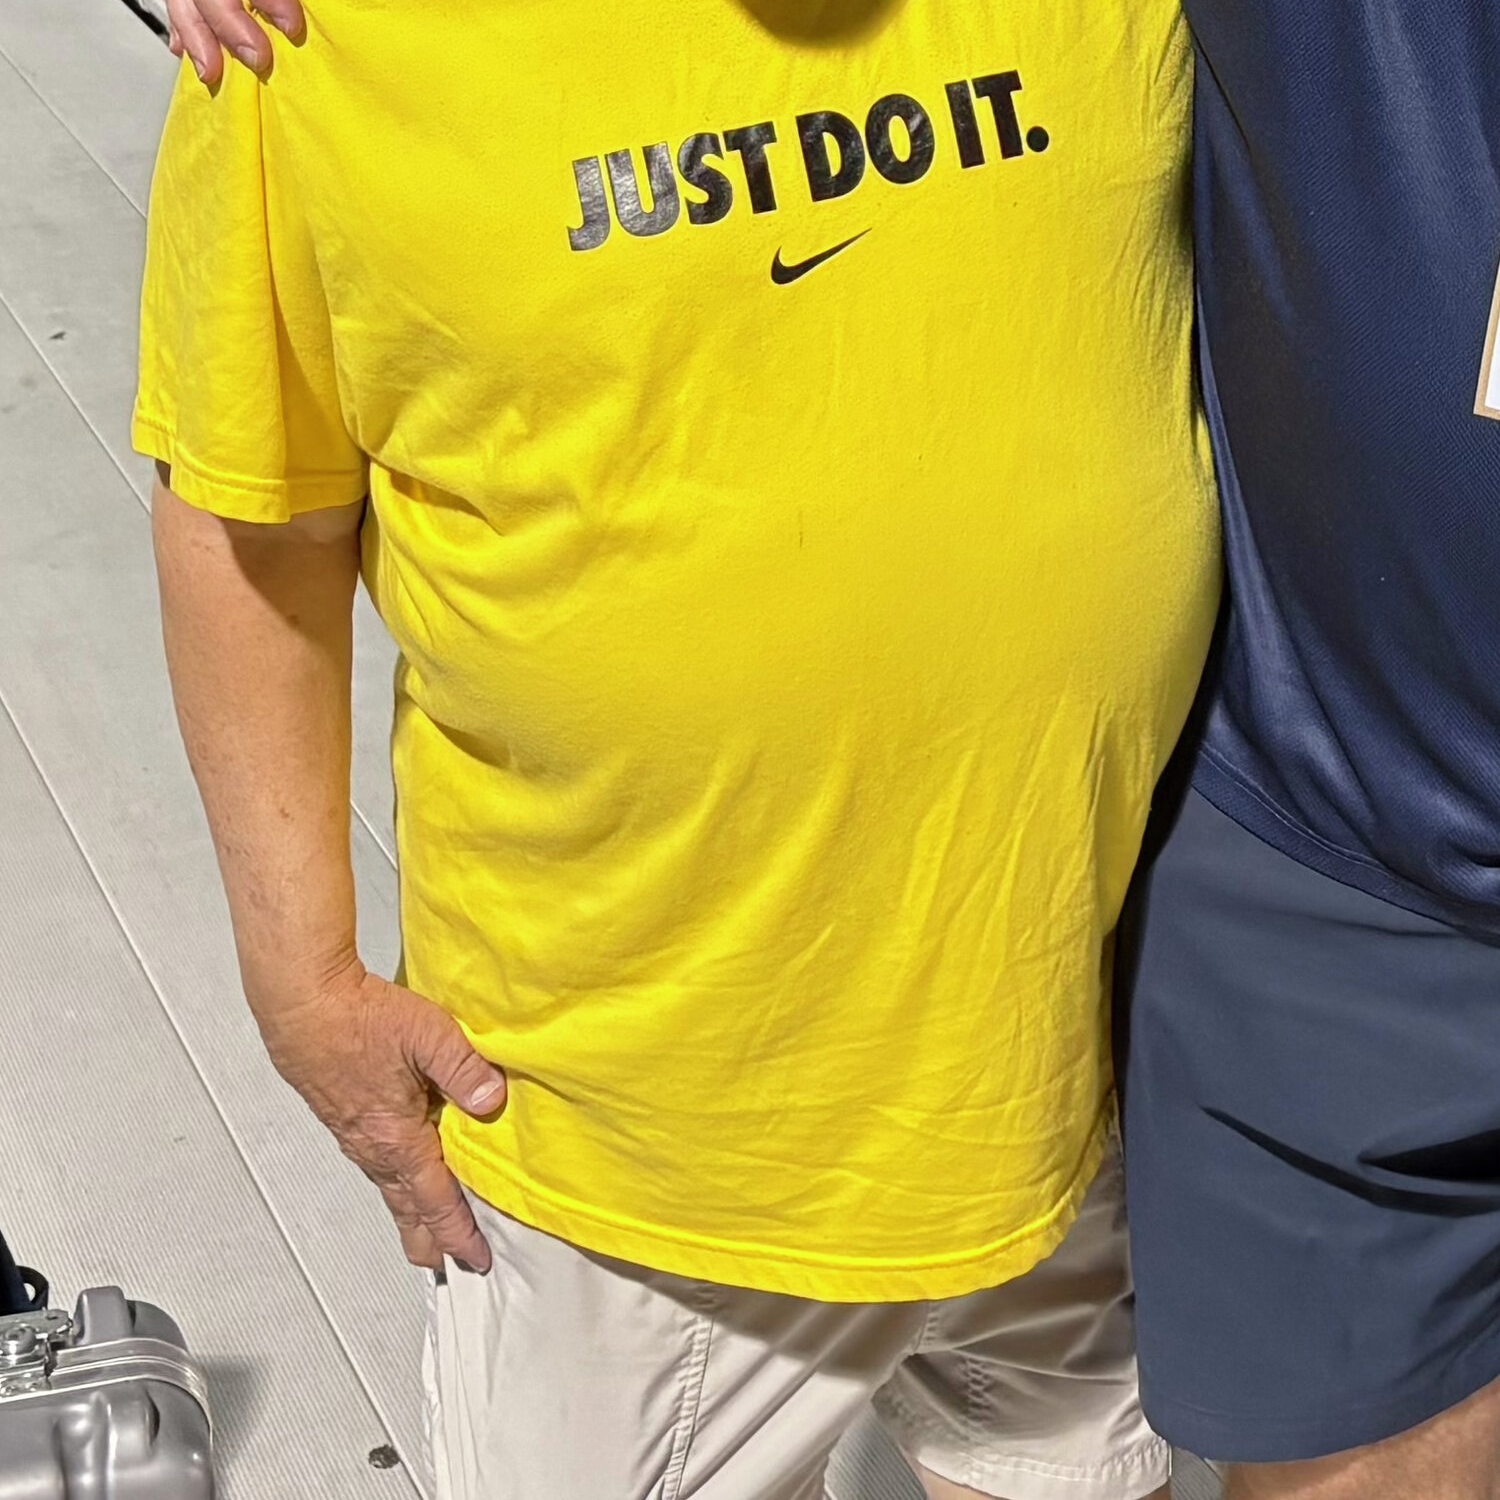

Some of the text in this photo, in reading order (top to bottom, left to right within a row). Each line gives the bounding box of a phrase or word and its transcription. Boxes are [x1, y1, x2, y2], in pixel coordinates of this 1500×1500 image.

[566, 68, 1051, 252] JUST DO IT.
